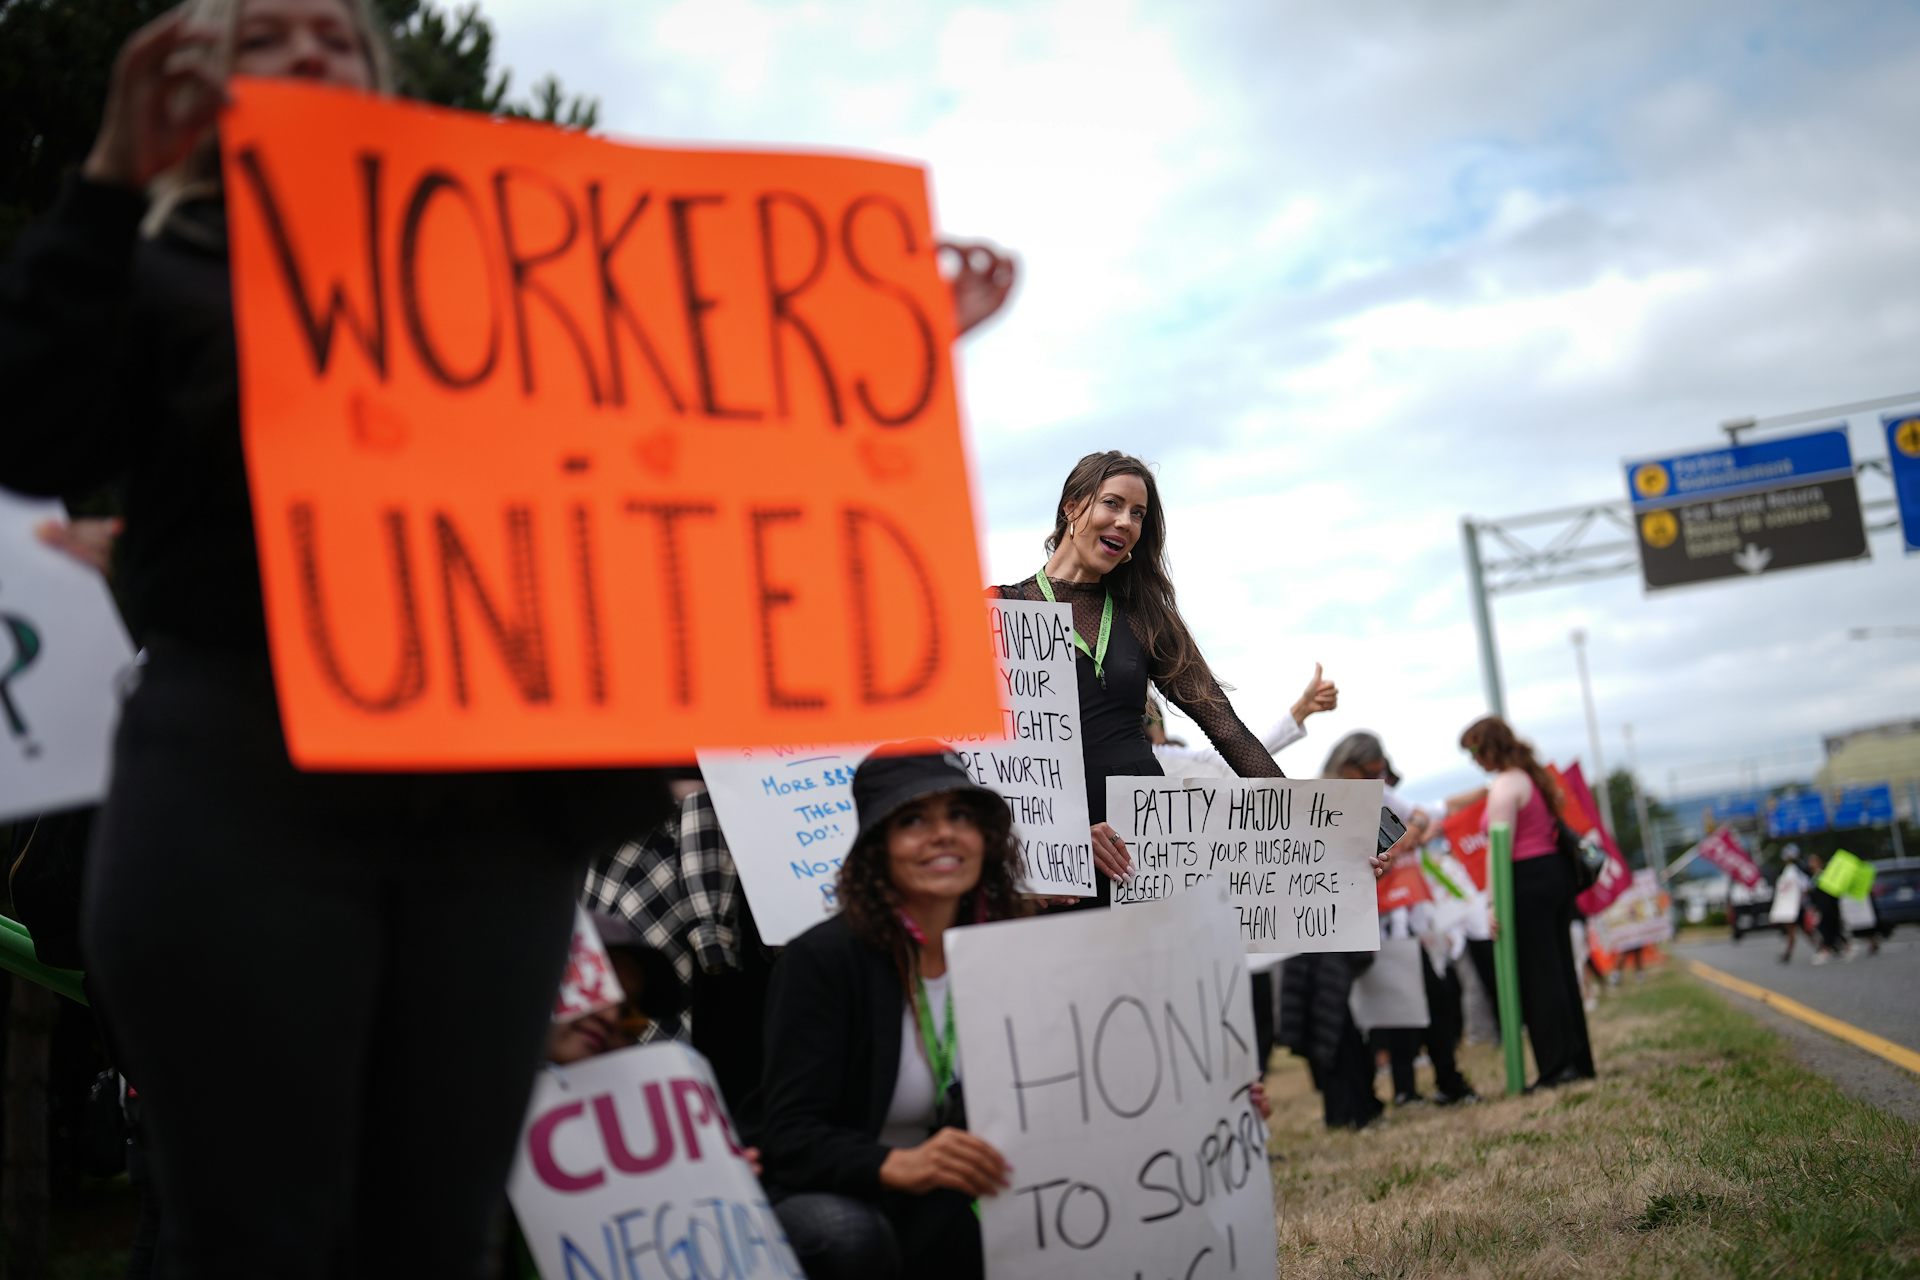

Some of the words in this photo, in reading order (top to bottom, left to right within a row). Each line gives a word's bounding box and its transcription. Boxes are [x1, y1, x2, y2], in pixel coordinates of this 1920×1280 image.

[237, 146, 940, 429] WORKERS
[986, 606, 1073, 662] ANADA:
[1000, 667, 1056, 697] YOUR
[997, 708, 1073, 742] TIGHTS
[761, 774, 818, 797] MORE
[958, 751, 987, 784] RE
[991, 752, 1062, 790] WORTH
[1003, 796, 1054, 826] THAN
[1133, 788, 1217, 836] PATTY
[1228, 788, 1292, 832] HAJDU
[1307, 792, 1344, 828] the
[1124, 841, 1199, 871] TIGHTS
[1207, 839, 1248, 870] YOUR
[1255, 839, 1326, 866] HUSBAND
[1114, 873, 1174, 903] BEGGED
[1229, 871, 1277, 896] HAVE
[1292, 902, 1337, 938] YOU!
[1003, 960, 1250, 1132] HONK
[1014, 1178, 1110, 1250] TO
